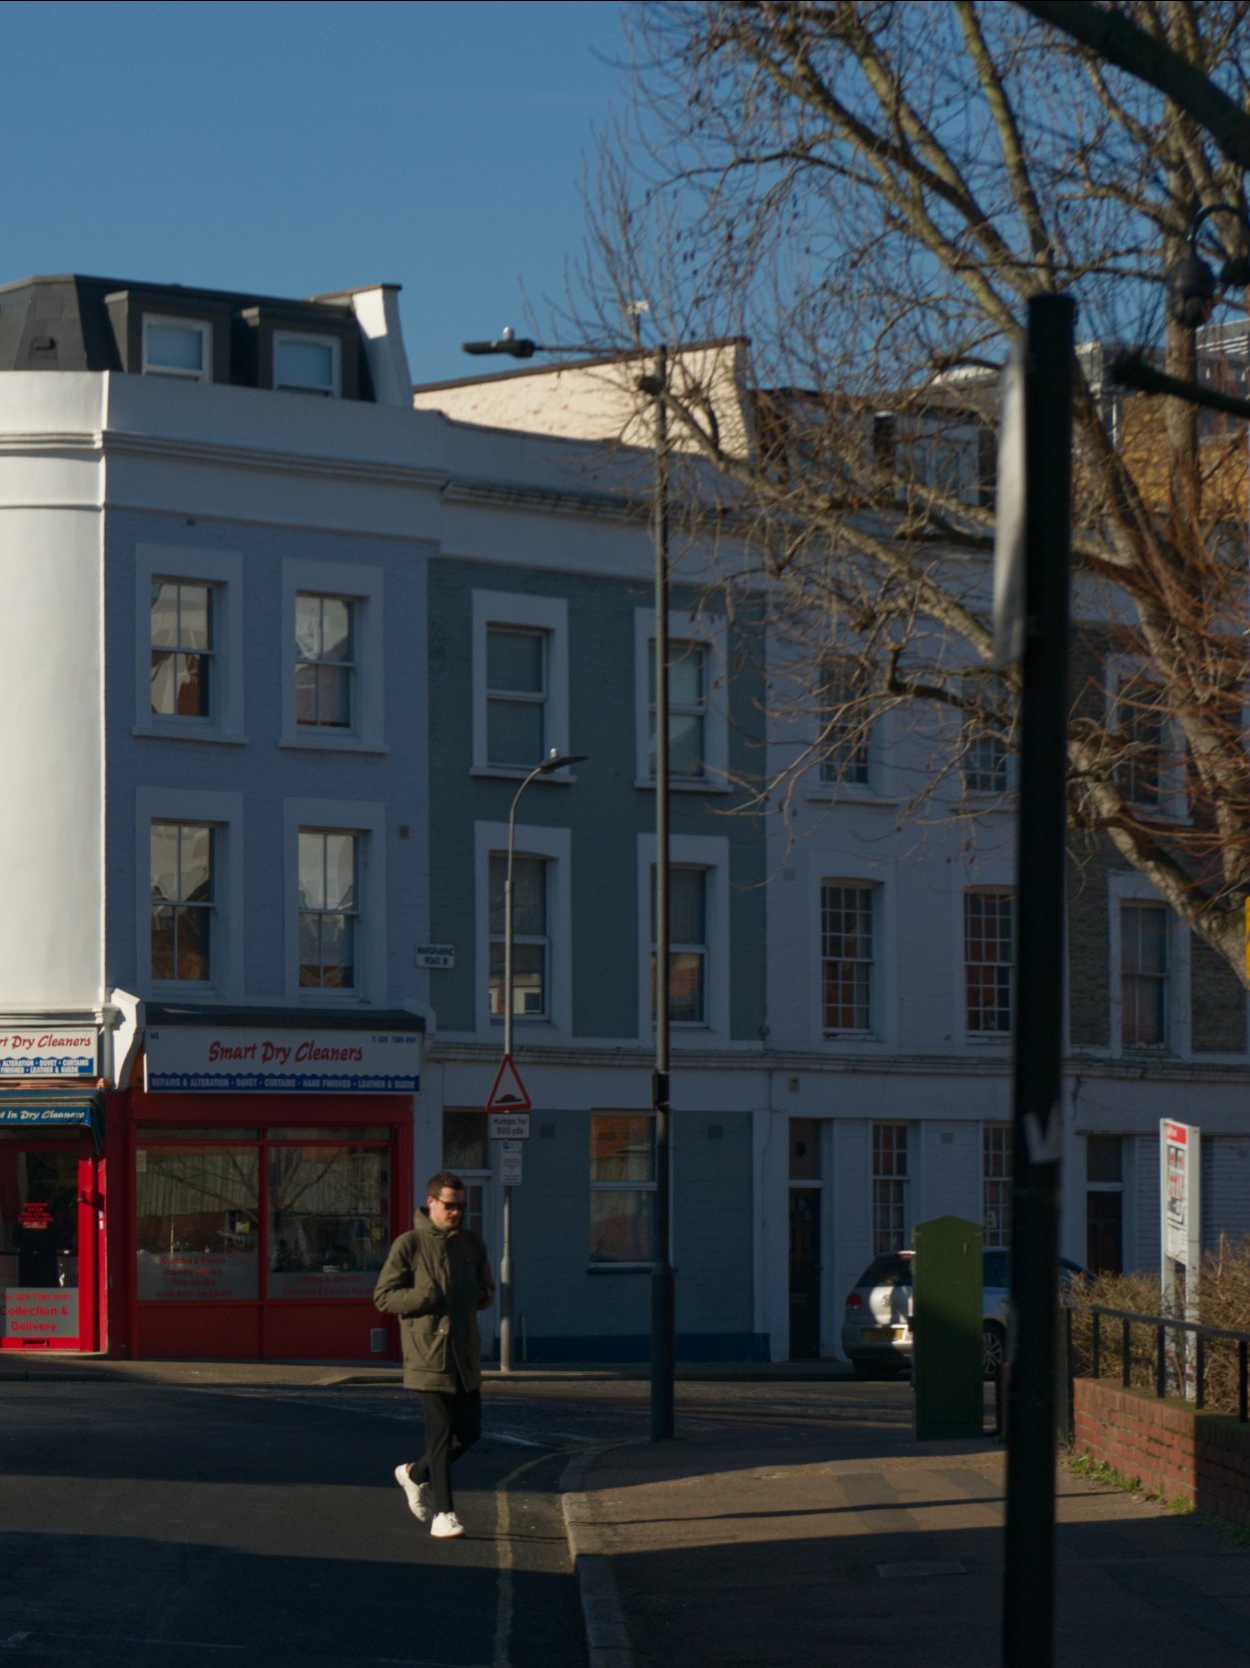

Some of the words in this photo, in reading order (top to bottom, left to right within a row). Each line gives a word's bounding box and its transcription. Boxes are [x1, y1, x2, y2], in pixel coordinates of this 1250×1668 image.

[424, 956, 441, 965] ROAD
[11, 1034, 34, 1050] Dry
[37, 1034, 91, 1048] Cleaners
[208, 1040, 257, 1062] Smart
[261, 1041, 292, 1065] Dry
[294, 1040, 363, 1062] Cleaners
[151, 1078, 180, 1087] REPAIRS
[189, 1078, 229, 1088] ALTERATION
[236, 1079, 257, 1088] DUVET
[264, 1079, 296, 1088] CURTAINS
[302, 1079, 321, 1088] HAND
[322, 1079, 351, 1088] FINISHED
[358, 1080, 385, 1088] LEATHER
[394, 1080, 415, 1088] SUEDE
[20, 1110, 39, 1120] Dry
[41, 1110, 85, 1119] Cleaners
[492, 1117, 516, 1125] Humps
[0, 1304, 57, 1316] Collection
[60, 1305, 68, 1316] &
[11, 1320, 57, 1333] Delivery
